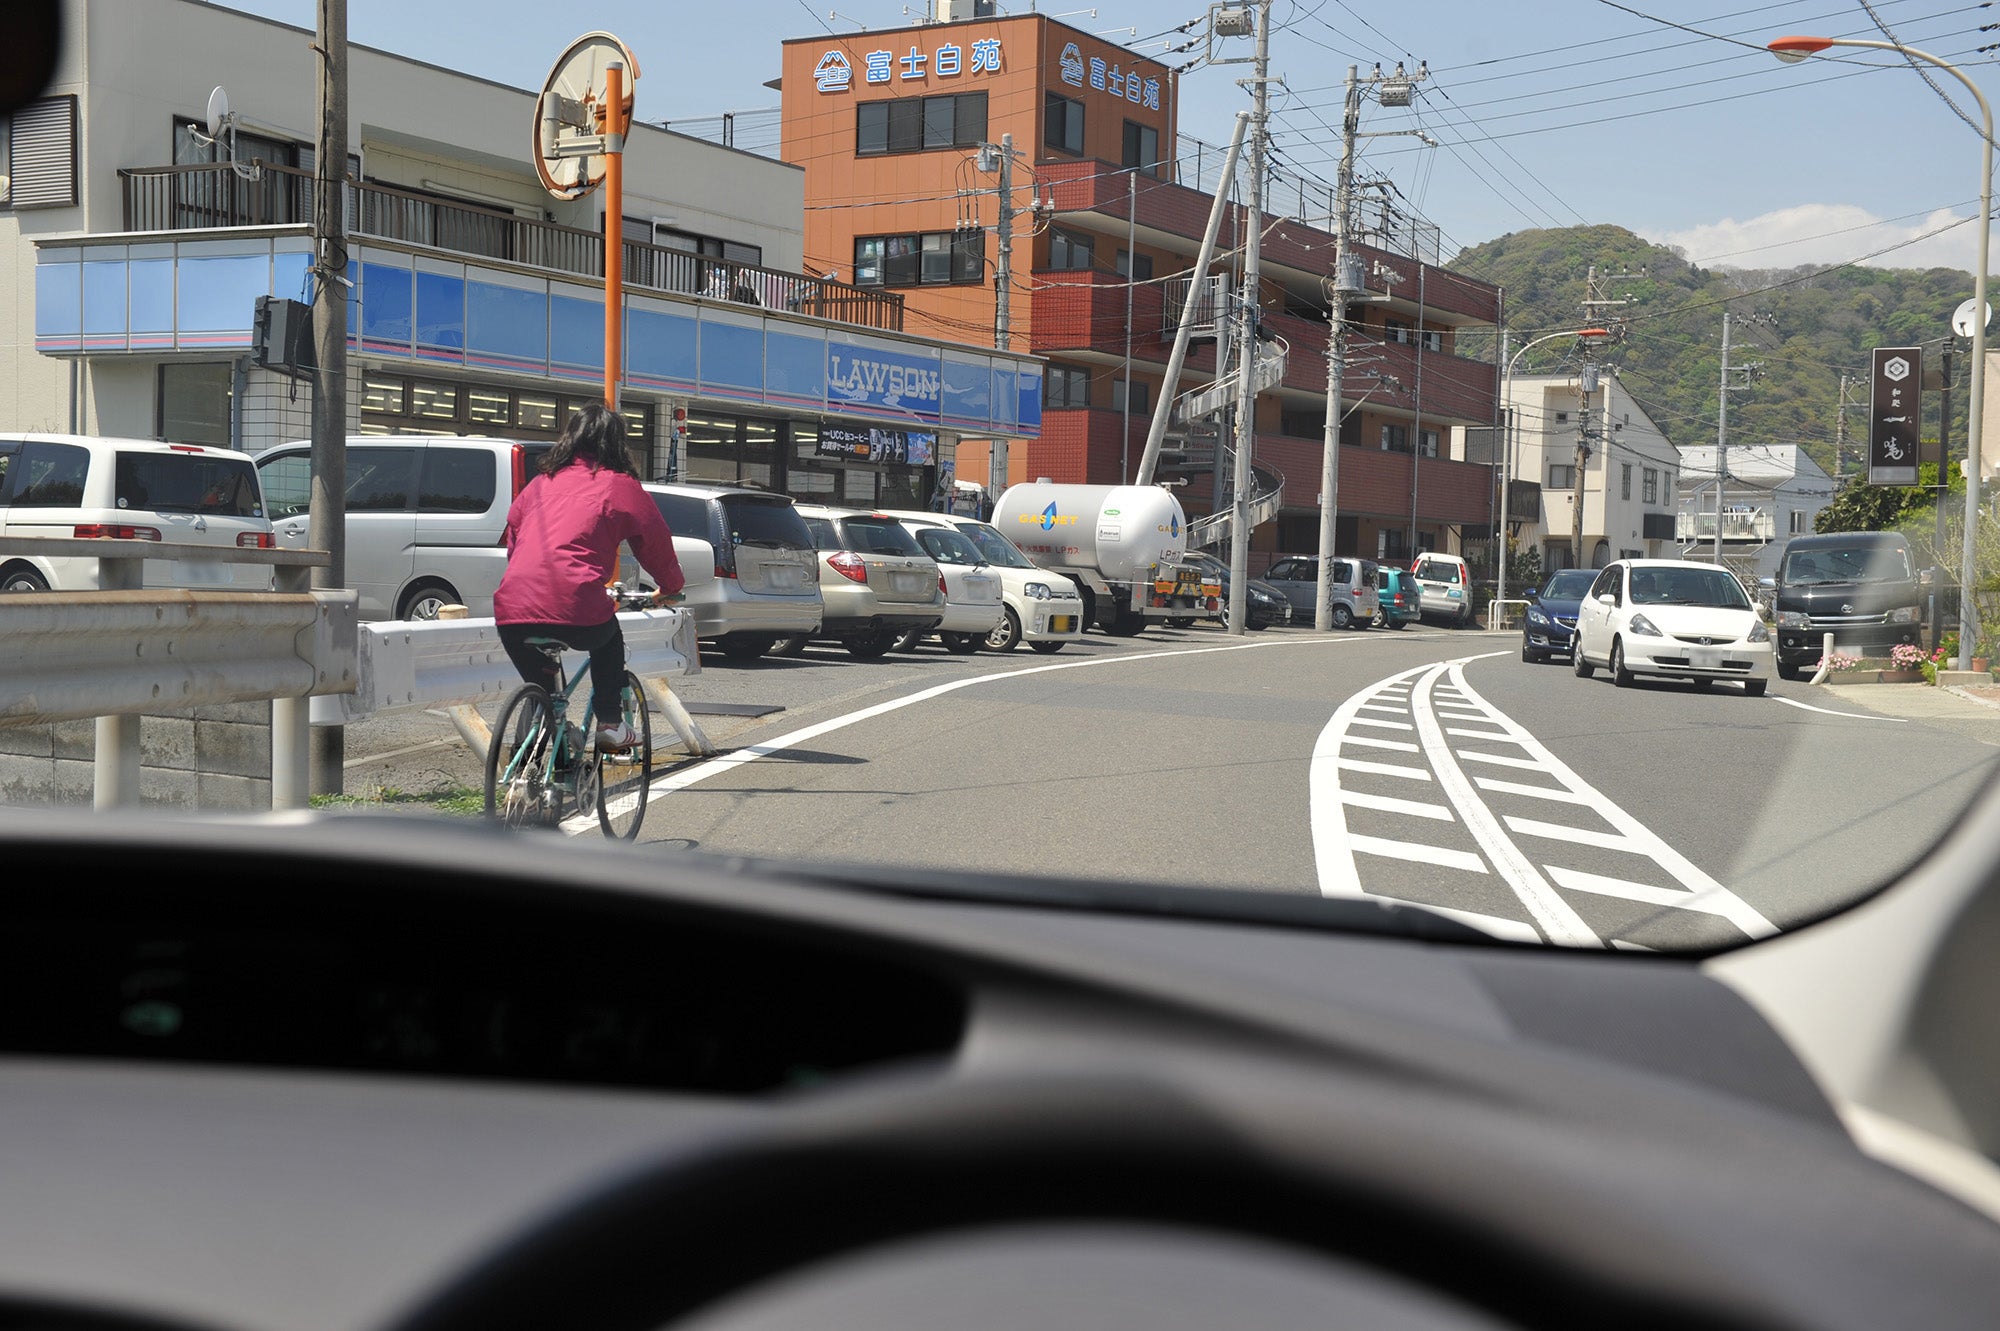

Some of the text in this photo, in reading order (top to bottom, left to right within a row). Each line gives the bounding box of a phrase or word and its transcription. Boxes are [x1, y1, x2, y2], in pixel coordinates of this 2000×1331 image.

[865, 38, 1002, 83] 富士白苑
[1089, 58, 1160, 111] 富士白苑
[831, 356, 938, 400] LAWSON
[1018, 513, 1079, 526] GAS NET
[1055, 545, 1080, 555] LPガス
[1159, 549, 1181, 561] LPガス
